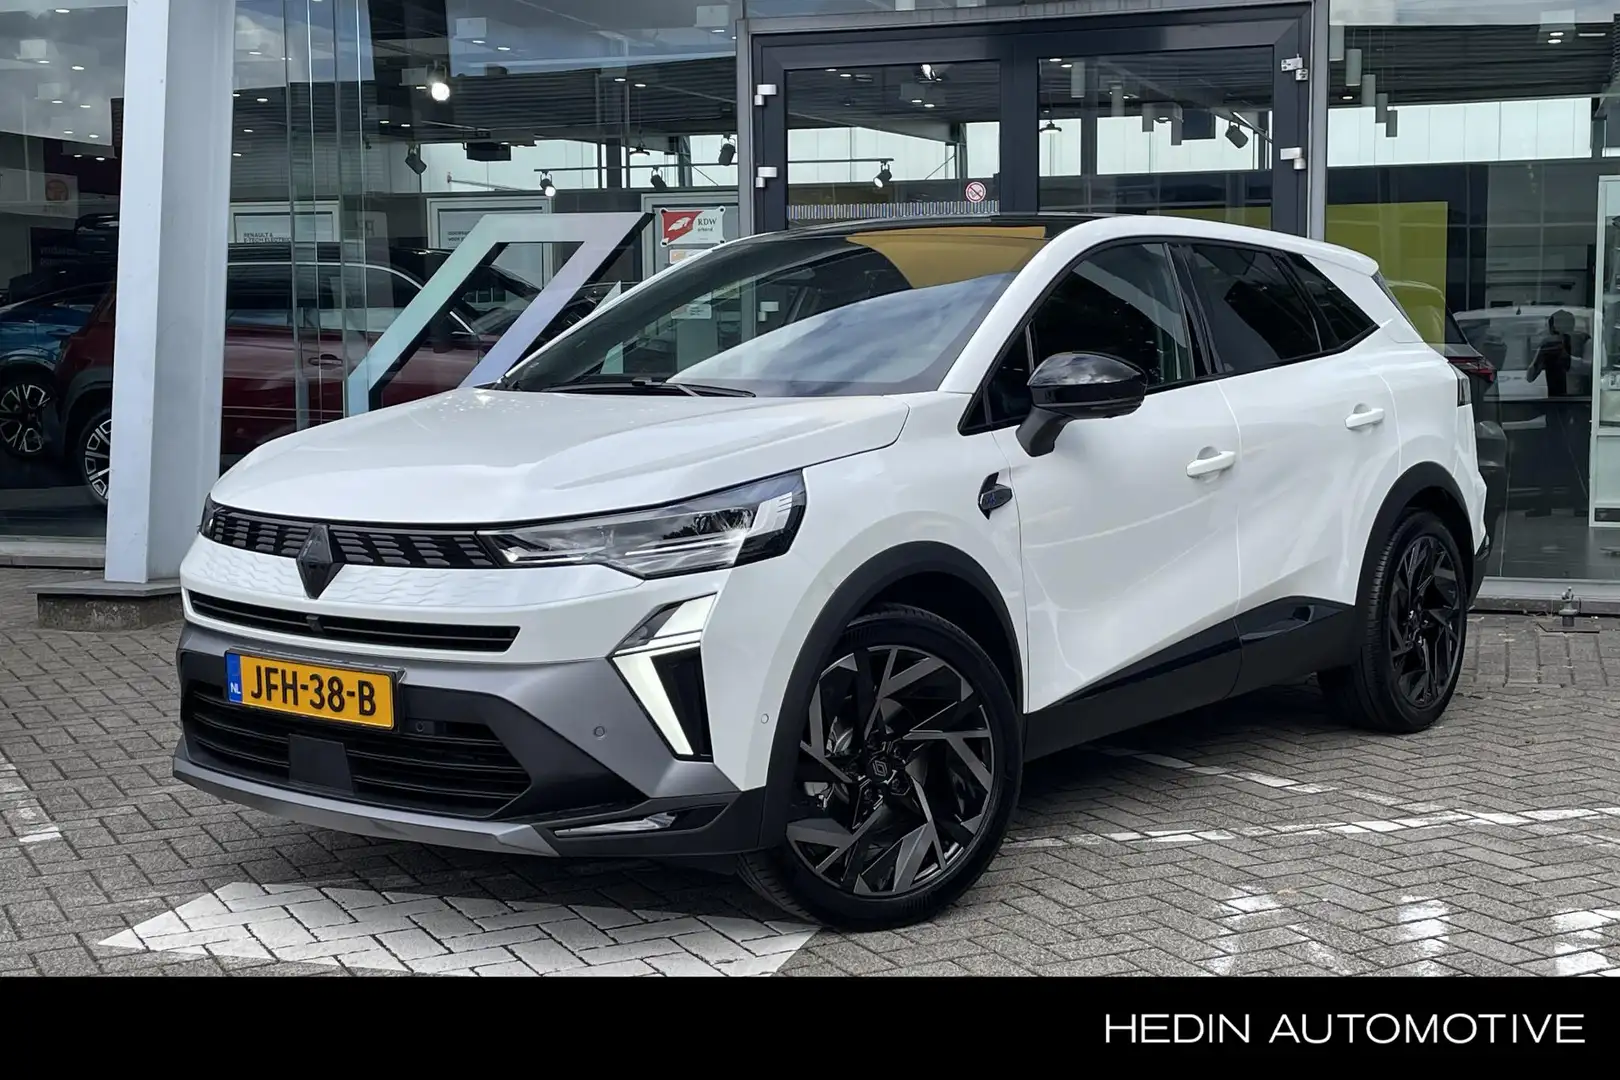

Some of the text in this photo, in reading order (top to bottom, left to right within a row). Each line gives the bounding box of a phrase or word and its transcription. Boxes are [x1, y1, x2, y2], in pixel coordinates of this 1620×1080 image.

[697, 217, 717, 226] RDW
[230, 682, 241, 695] NL
[251, 665, 376, 717] JFH-38-B
